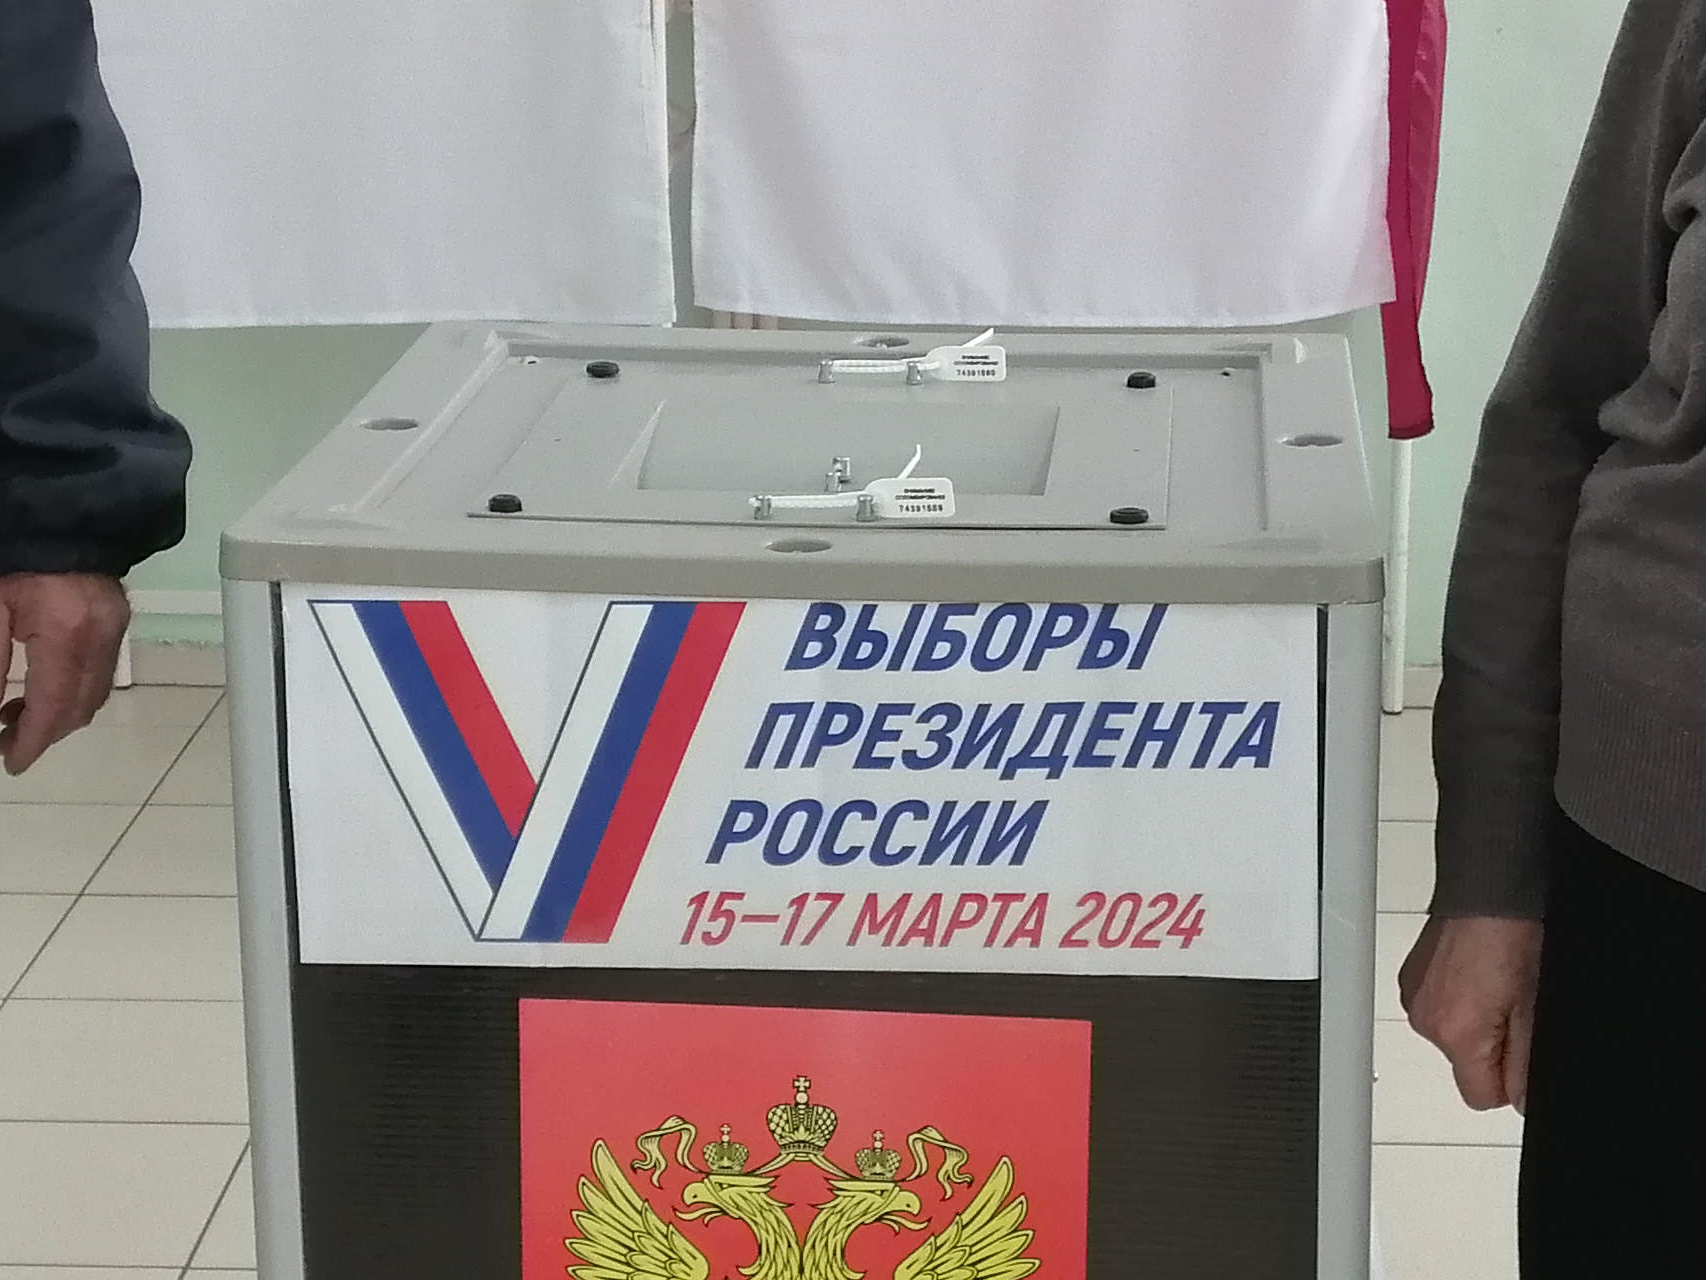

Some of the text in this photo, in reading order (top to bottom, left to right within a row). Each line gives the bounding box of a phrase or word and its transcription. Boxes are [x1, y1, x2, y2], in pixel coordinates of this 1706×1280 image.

[783, 602, 1169, 673] ВЫБОРЫ
[743, 700, 1283, 781] ПРЕЗИДЕНТА
[704, 798, 1049, 868] РОССИИ
[848, 891, 1049, 949] МАРТА
[1057, 891, 1208, 950] 2024
